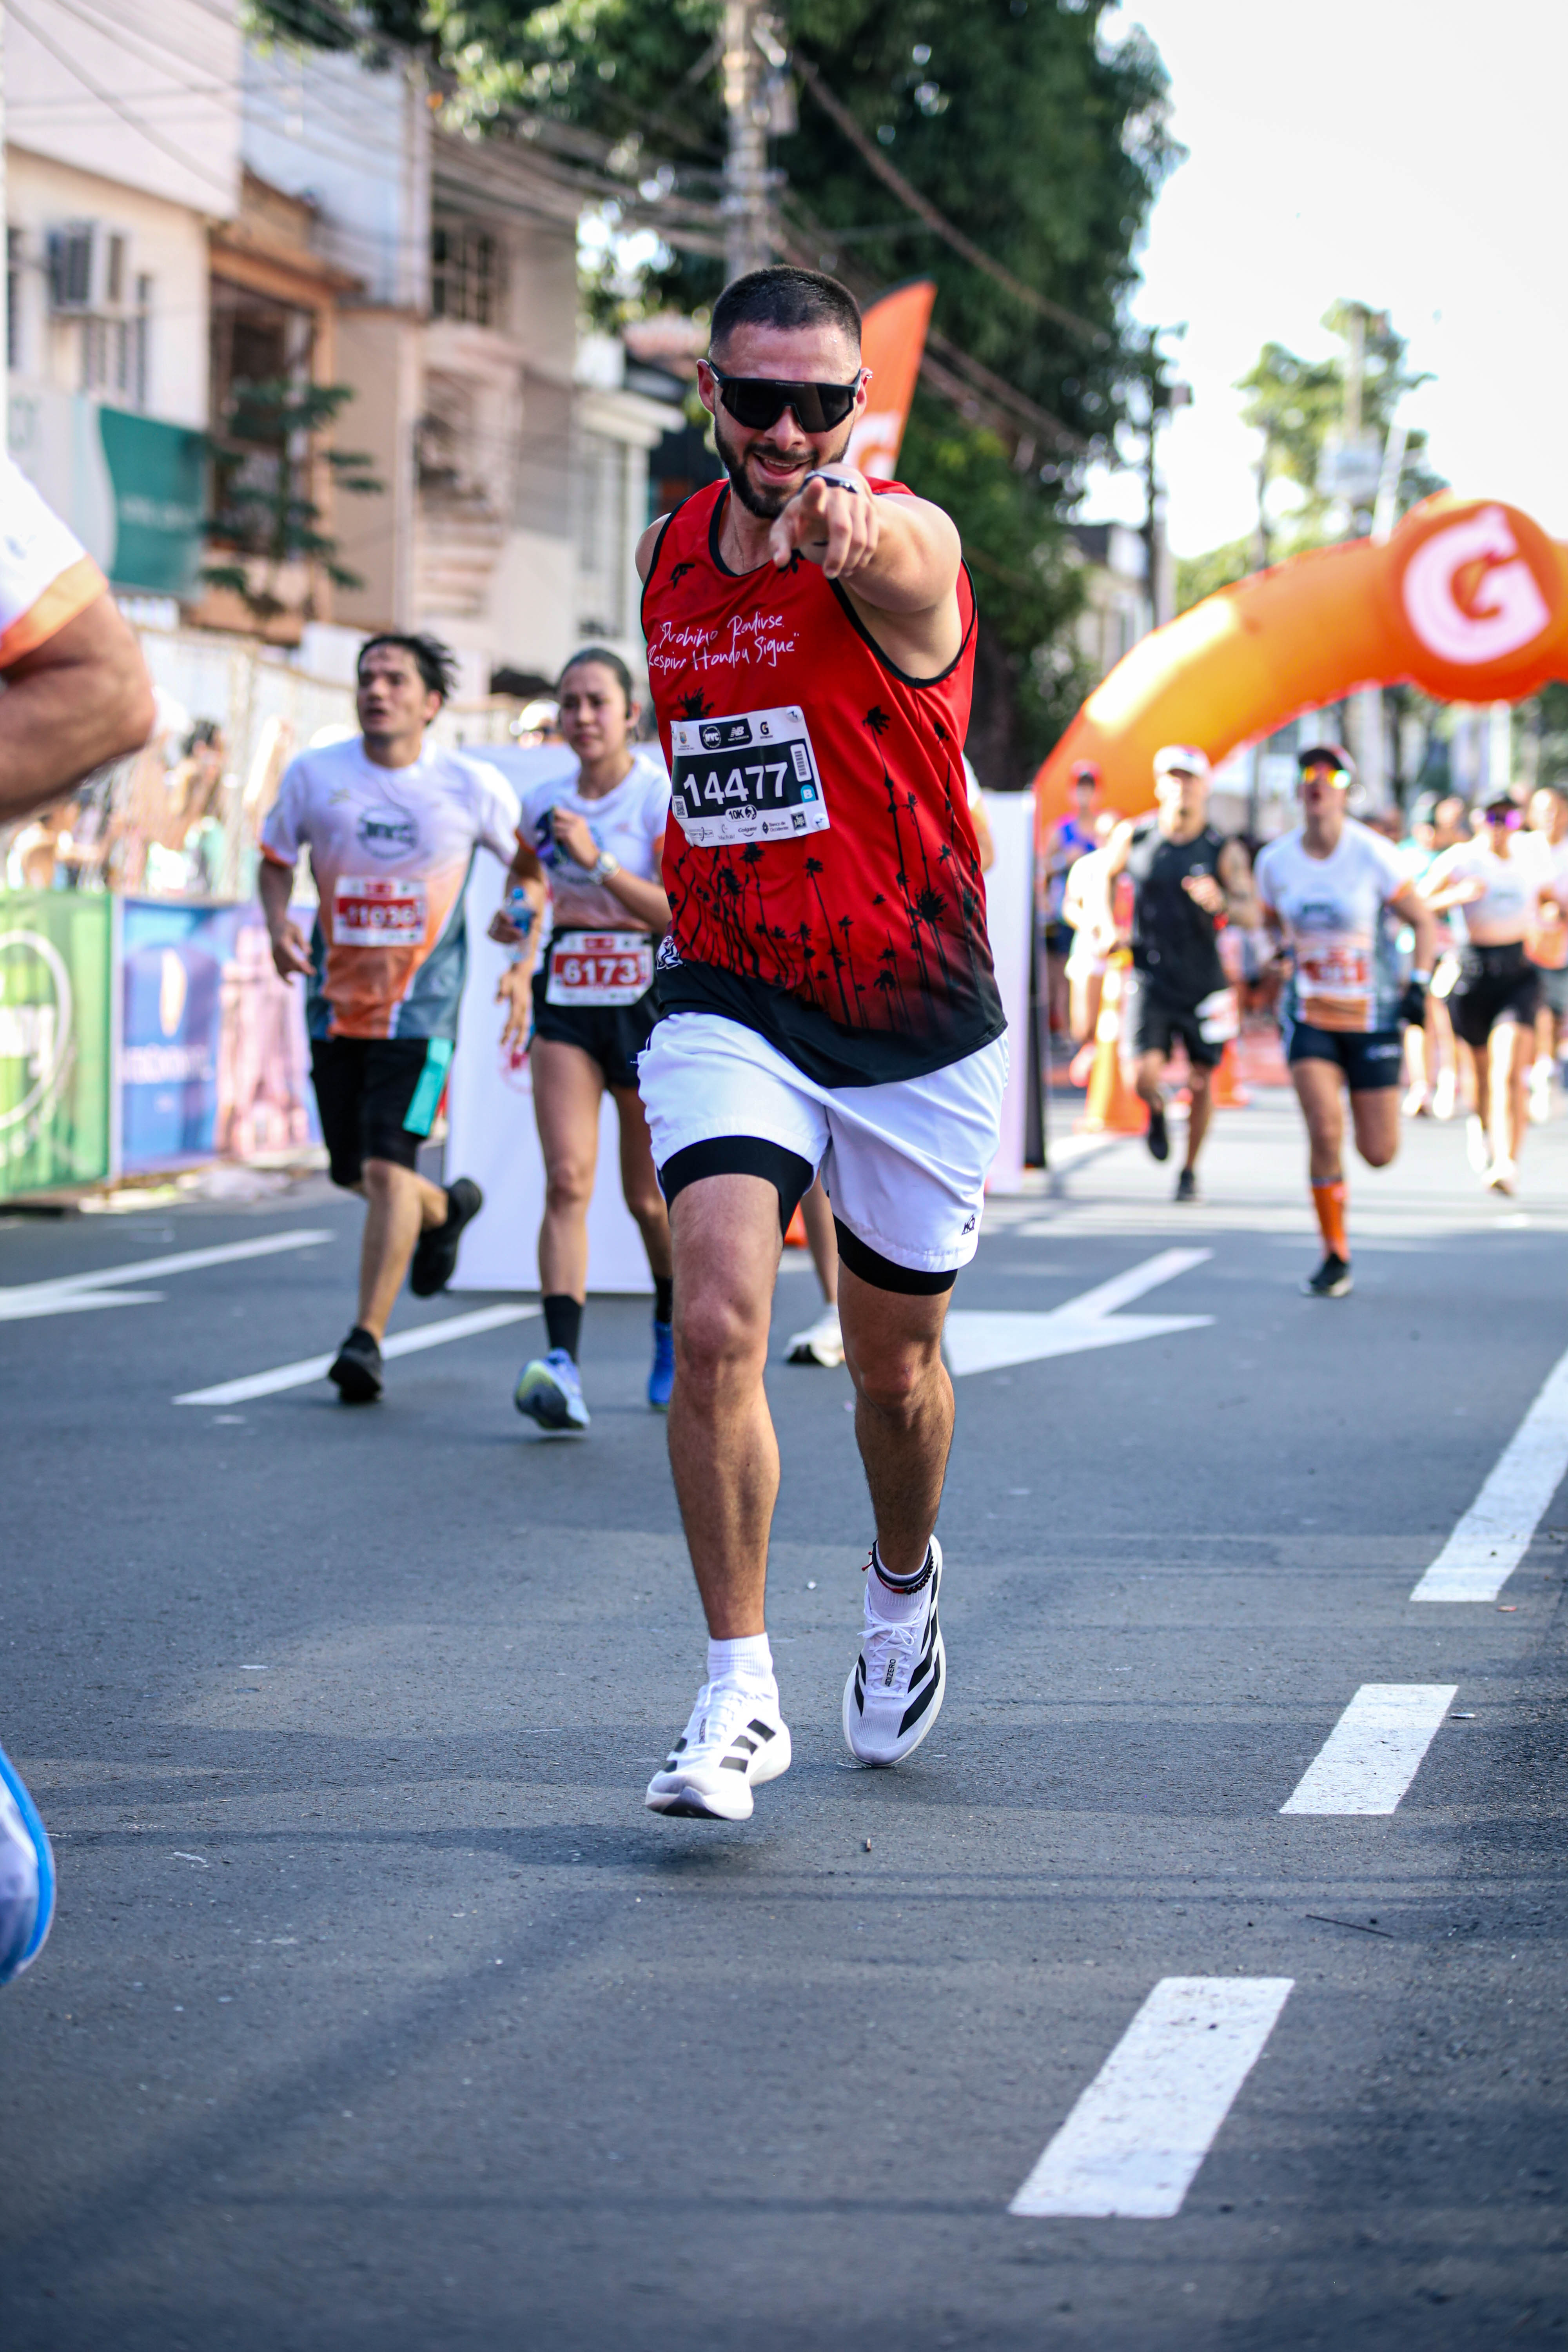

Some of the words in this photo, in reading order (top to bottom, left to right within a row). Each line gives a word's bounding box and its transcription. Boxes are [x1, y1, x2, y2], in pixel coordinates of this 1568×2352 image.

[1402, 506, 1552, 664] G
[684, 762, 788, 807] 14477
[803, 789, 813, 799] B
[729, 809, 744, 820] 10K
[562, 957, 637, 985] 6173
